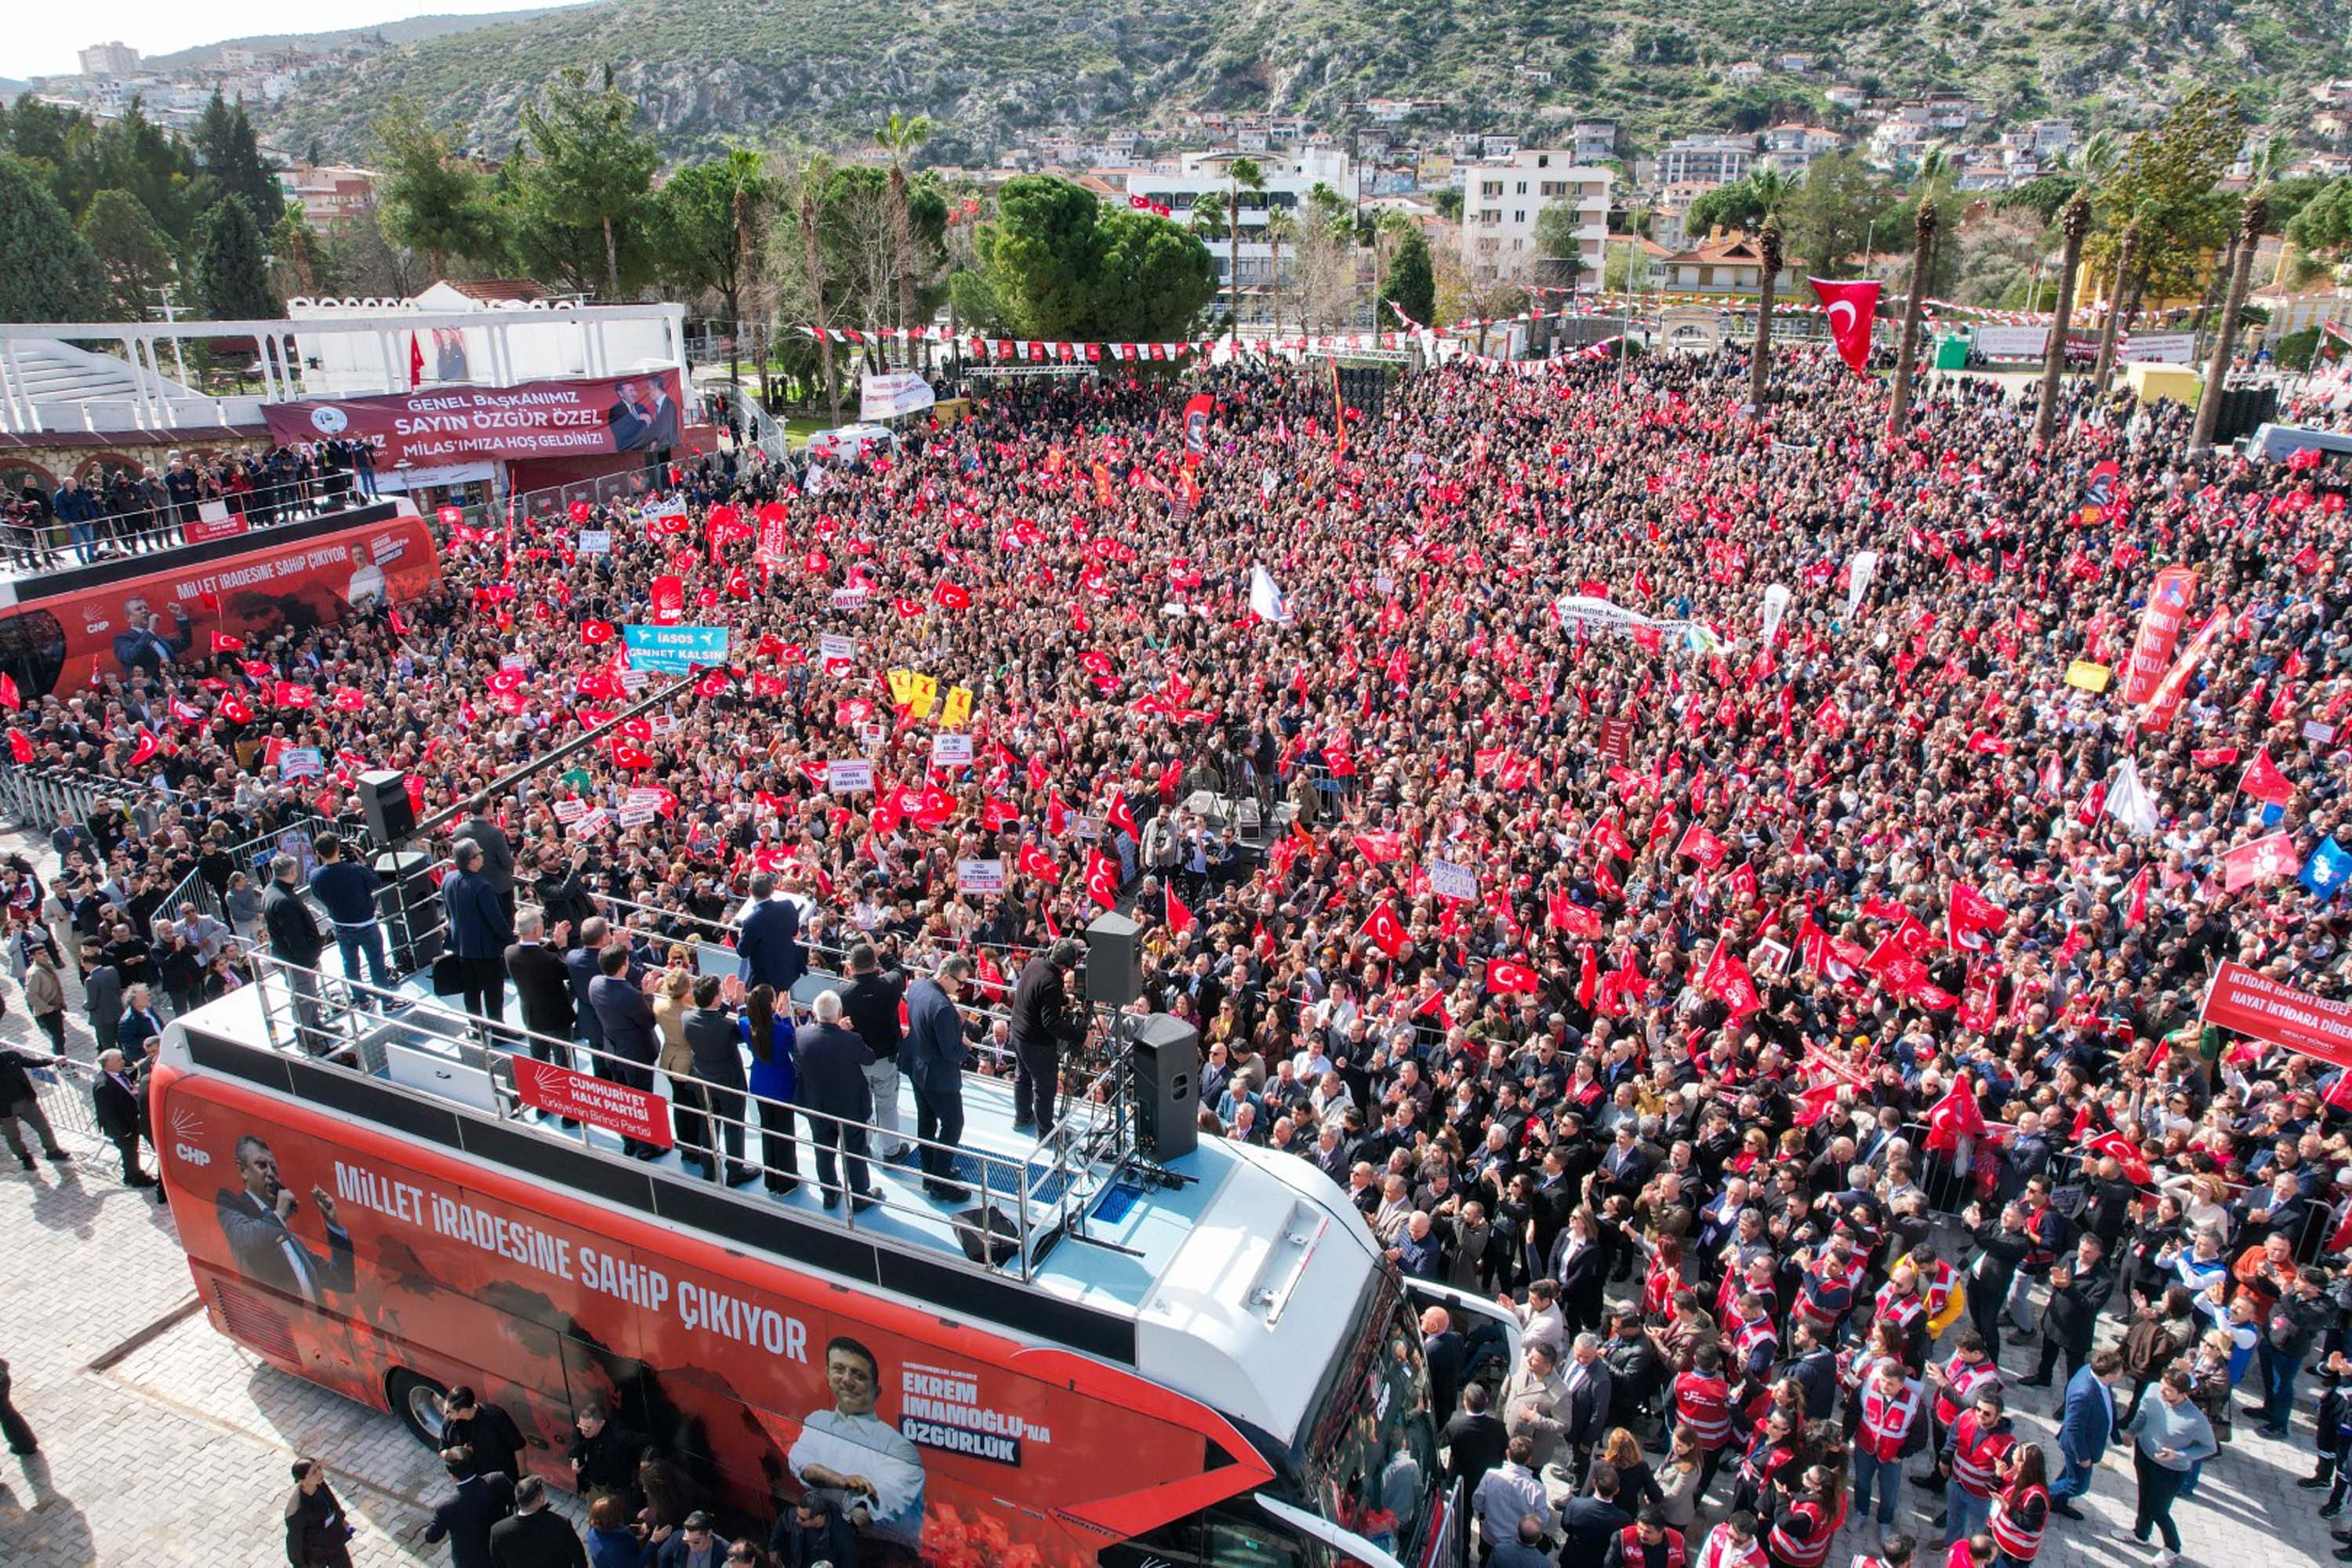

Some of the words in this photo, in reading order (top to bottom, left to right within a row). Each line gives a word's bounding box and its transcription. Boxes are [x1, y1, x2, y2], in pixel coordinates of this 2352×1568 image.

[408, 395, 470, 412] GENEL
[474, 391, 580, 408] BAŞKANIMIZ
[394, 416, 469, 436] SAYIN
[474, 409, 547, 430] ÖZGÜR
[553, 408, 602, 426] ÖZEL
[506, 435, 537, 452] HOŞ
[539, 432, 603, 447] GELDİNİZ!
[307, 546, 347, 568] ÇIKIYOR
[86, 620, 110, 635] CHP
[1692, 846, 1713, 860] CHP
[2229, 970, 2275, 993] İKTİDAR
[2231, 991, 2267, 1010] HAYAT
[2267, 1000, 2318, 1028] İKTİDARA
[568, 1076, 647, 1108] CUMHURİYET
[572, 1090, 604, 1108] HALK
[604, 1098, 649, 1121] PARTİSİ
[539, 1094, 588, 1118] Türkiye'nin
[590, 1110, 619, 1128] Birinci
[620, 1119, 652, 1137] Partisi
[176, 1142, 211, 1167] CHP
[679, 1281, 808, 1365] ÇIKIYOR
[903, 1371, 978, 1405] EKREM
[903, 1393, 1051, 1443] İMAMOĞLU'NA
[902, 1418, 1015, 1461] ÖZGÜRLÜK
